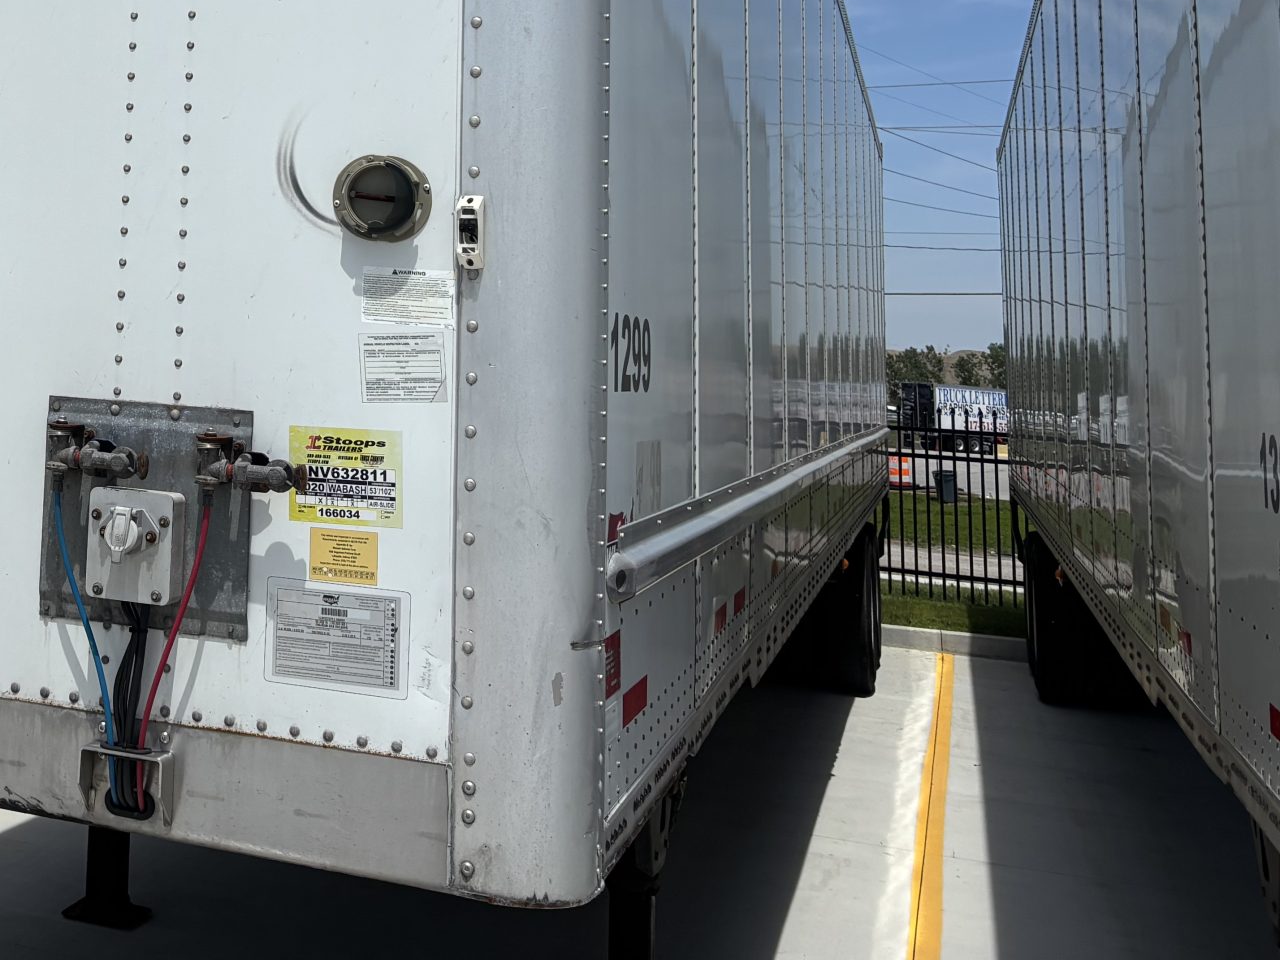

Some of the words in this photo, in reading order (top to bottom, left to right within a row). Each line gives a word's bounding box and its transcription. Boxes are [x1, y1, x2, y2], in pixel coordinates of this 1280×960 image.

[610, 312, 652, 393] 1299
[938, 387, 967, 404] TRUCK
[322, 435, 387, 448] Stoops
[322, 444, 364, 453] TRAILERS
[305, 482, 325, 492] 020
[328, 484, 367, 495] WABASH
[368, 501, 395, 509] AIR-SLIDE
[318, 507, 361, 519] 166034
